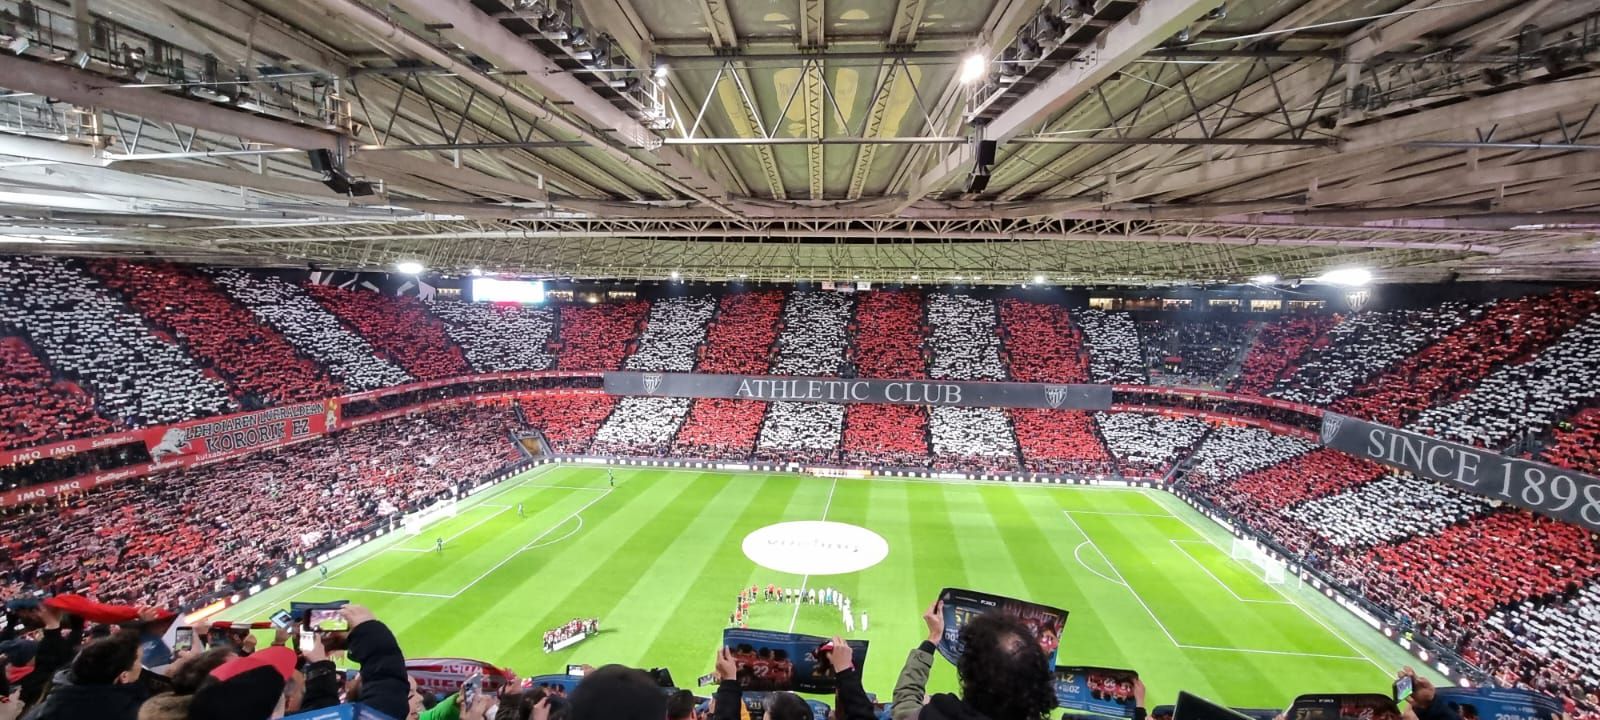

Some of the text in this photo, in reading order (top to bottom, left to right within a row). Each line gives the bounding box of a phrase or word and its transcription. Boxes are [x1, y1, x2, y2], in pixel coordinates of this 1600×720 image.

[735, 378, 963, 404] ATHLETIC CLUB
[206, 422, 287, 453] KORORIK
[291, 418, 311, 437] EZ
[12, 444, 76, 463] IMQ IMQ
[1367, 428, 1600, 526] SINCE 1898
[17, 488, 46, 502] IMQ
[53, 480, 81, 493] IMQ
[752, 664, 770, 678] 22
